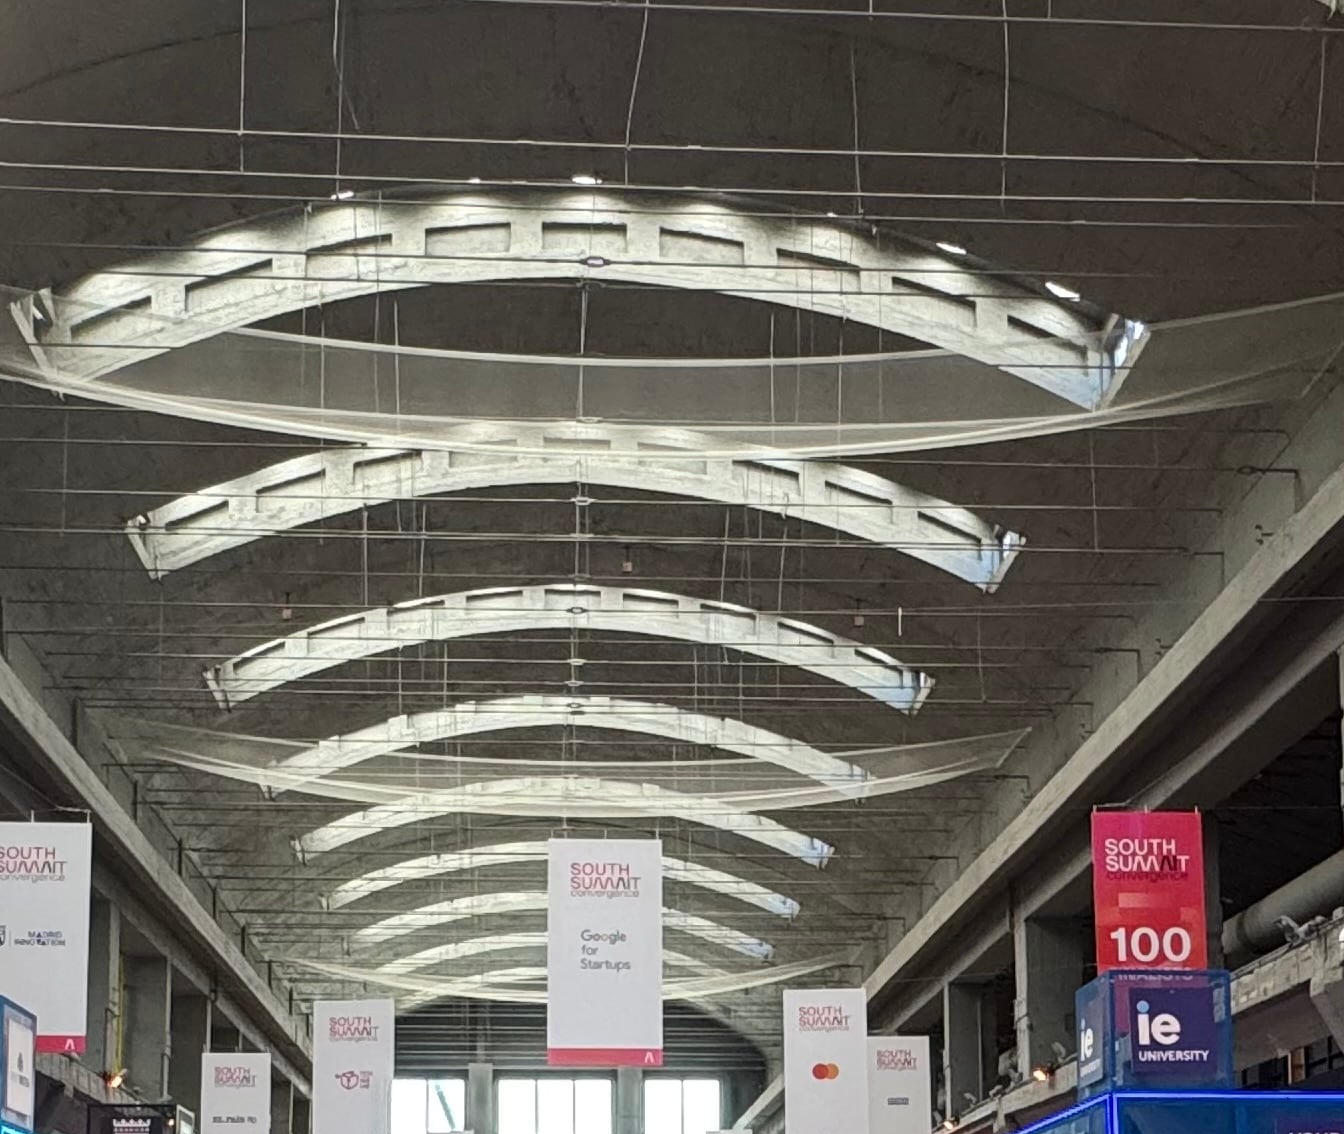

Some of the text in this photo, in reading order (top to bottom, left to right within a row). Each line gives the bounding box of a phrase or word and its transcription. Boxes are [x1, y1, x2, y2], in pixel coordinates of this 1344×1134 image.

[1105, 838, 1176, 856] SOUTH
[570, 862, 629, 876] SOUTH
[1106, 855, 1189, 872] SUMMIT
[570, 876, 640, 890] SUMMIT
[581, 929, 626, 945] Google
[581, 944, 598, 955] for
[1110, 927, 1192, 962] 100
[580, 958, 631, 973] Startups
[799, 1005, 842, 1017] SOUTH
[329, 1016, 371, 1027] SOUTH
[1136, 1000, 1181, 1046] ie
[1138, 1049, 1210, 1062] UNIVERSITY
